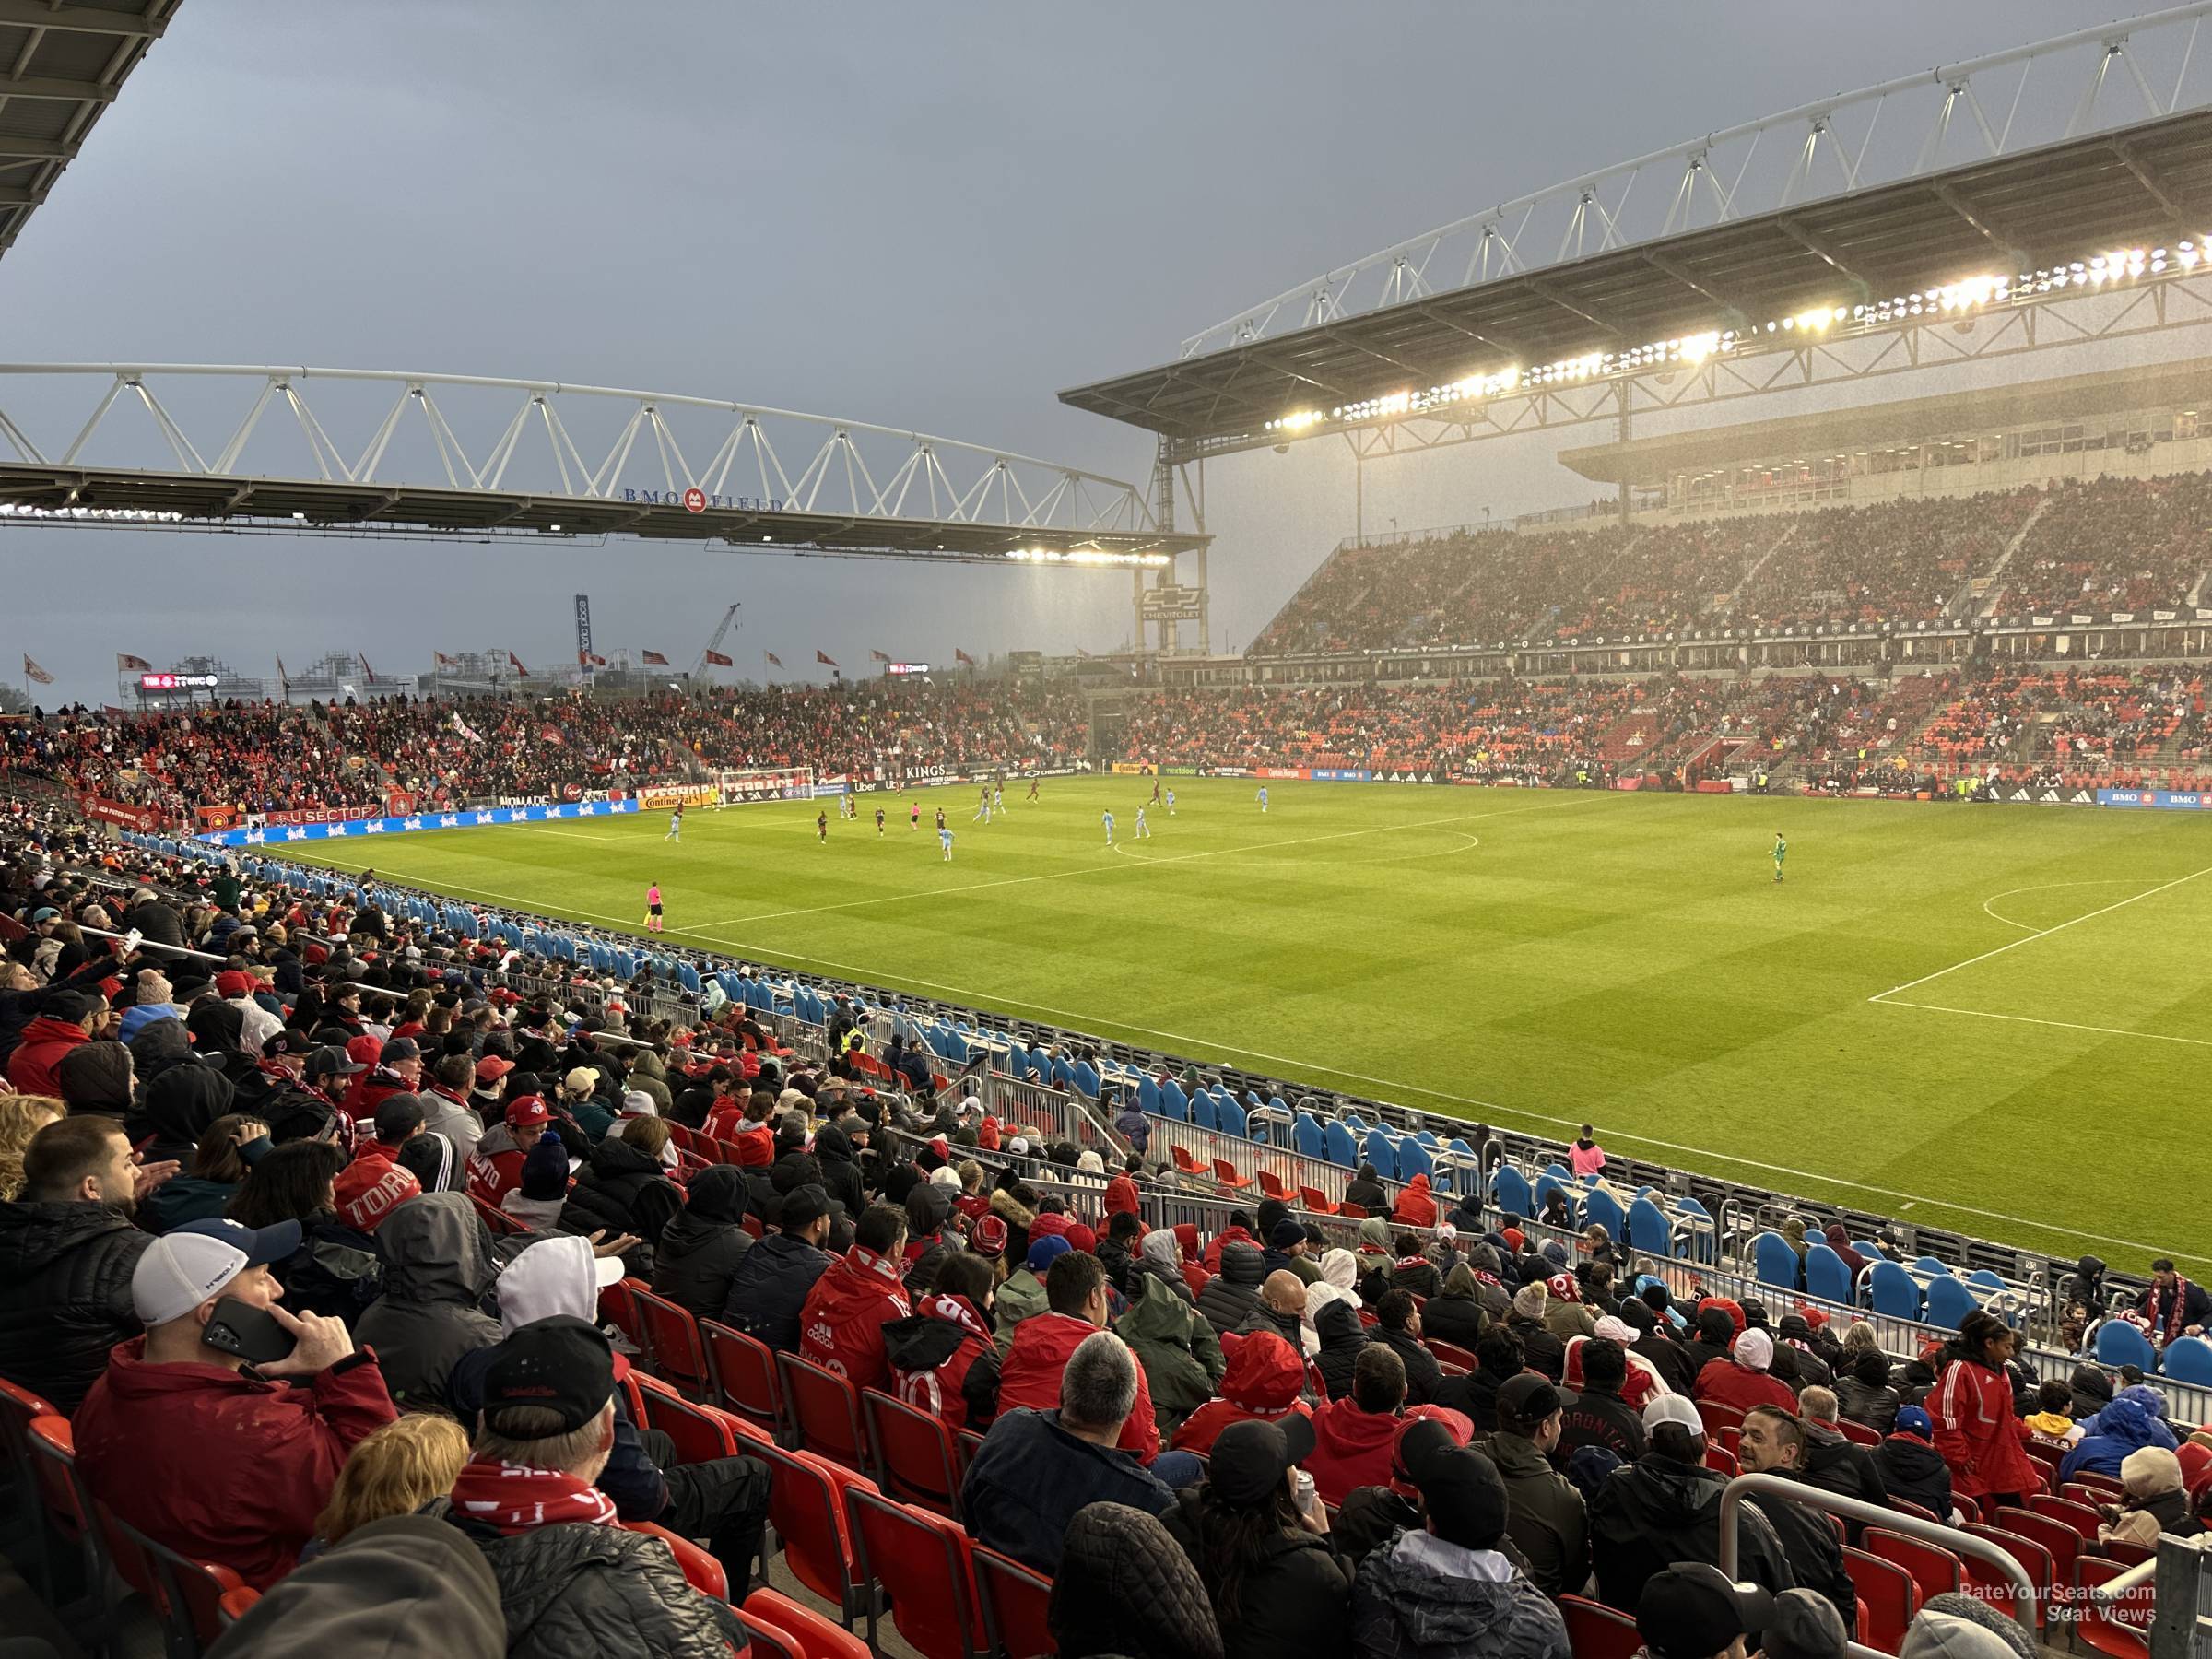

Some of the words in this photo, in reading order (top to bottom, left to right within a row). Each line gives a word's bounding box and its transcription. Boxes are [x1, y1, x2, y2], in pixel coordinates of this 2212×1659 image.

[625, 488, 679, 506] BMO
[712, 495, 782, 512] FIELD
[579, 600, 589, 627] place
[1143, 610, 1199, 619] CHEVROLET
[906, 764, 946, 779] KINGS
[854, 782, 877, 793] Uber
[885, 780, 905, 790] Ubr
[2112, 794, 2138, 802] BMO
[2171, 795, 2197, 804] BMO
[807, 1327, 835, 1350] adidas
[1561, 1410, 1628, 1452] ORONTO
